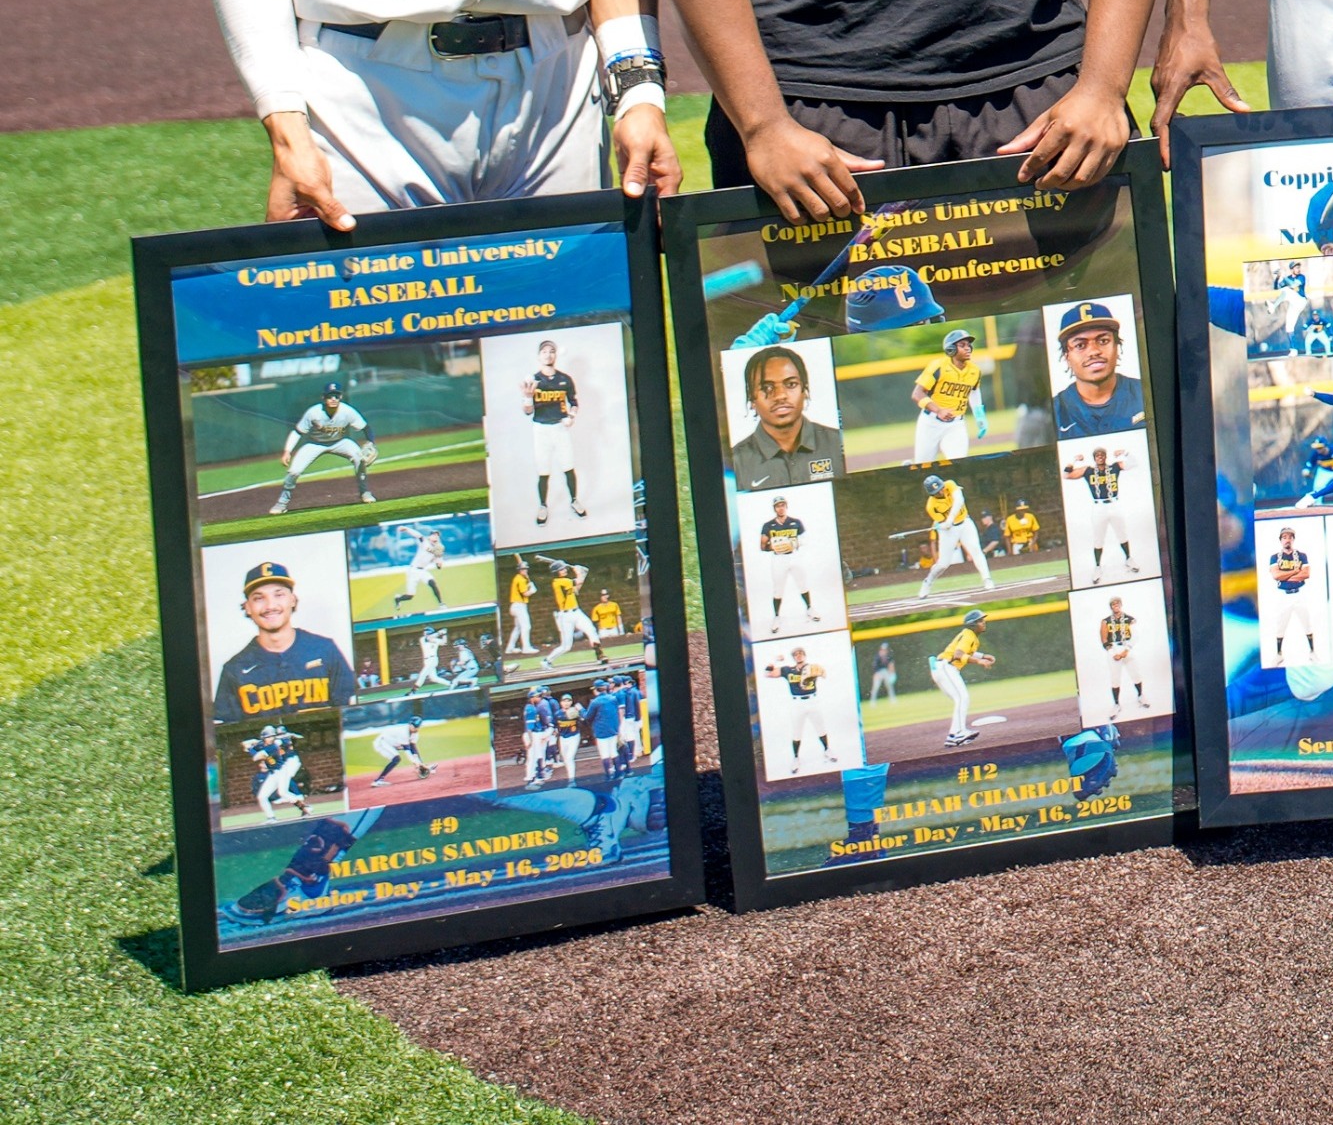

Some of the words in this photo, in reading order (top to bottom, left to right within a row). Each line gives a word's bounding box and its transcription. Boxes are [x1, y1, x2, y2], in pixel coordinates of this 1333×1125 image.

[760, 216, 853, 245] Coppin
[860, 206, 928, 230] State
[934, 190, 1071, 222] University
[238, 262, 335, 288] Coppin
[343, 251, 413, 277] State
[423, 237, 564, 267] University
[848, 227, 994, 264] BASEBALL
[330, 276, 483, 309] BASEBALL
[780, 272, 911, 304] Northeast
[917, 250, 1064, 284] Conference
[258, 319, 394, 346] Northeast
[402, 300, 555, 332] Conference
[940, 382, 973, 399] COPPIN
[239, 677, 330, 715] COPPIN
[957, 763, 999, 784] #12
[874, 796, 963, 825] ELIJAH
[968, 775, 1086, 811] CHARLOT
[430, 816, 459, 836] #9
[829, 834, 908, 857] Senior
[913, 825, 958, 845] Day
[980, 813, 1028, 838] May
[1039, 804, 1073, 825] 16,
[1077, 794, 1133, 818] 2026
[328, 844, 437, 878] MARCUS
[442, 827, 560, 862] SANDERS
[287, 884, 367, 912] Senior
[375, 878, 420, 903] Day
[445, 866, 493, 894] May
[506, 859, 540, 878] 16,
[546, 848, 603, 872] 2026
